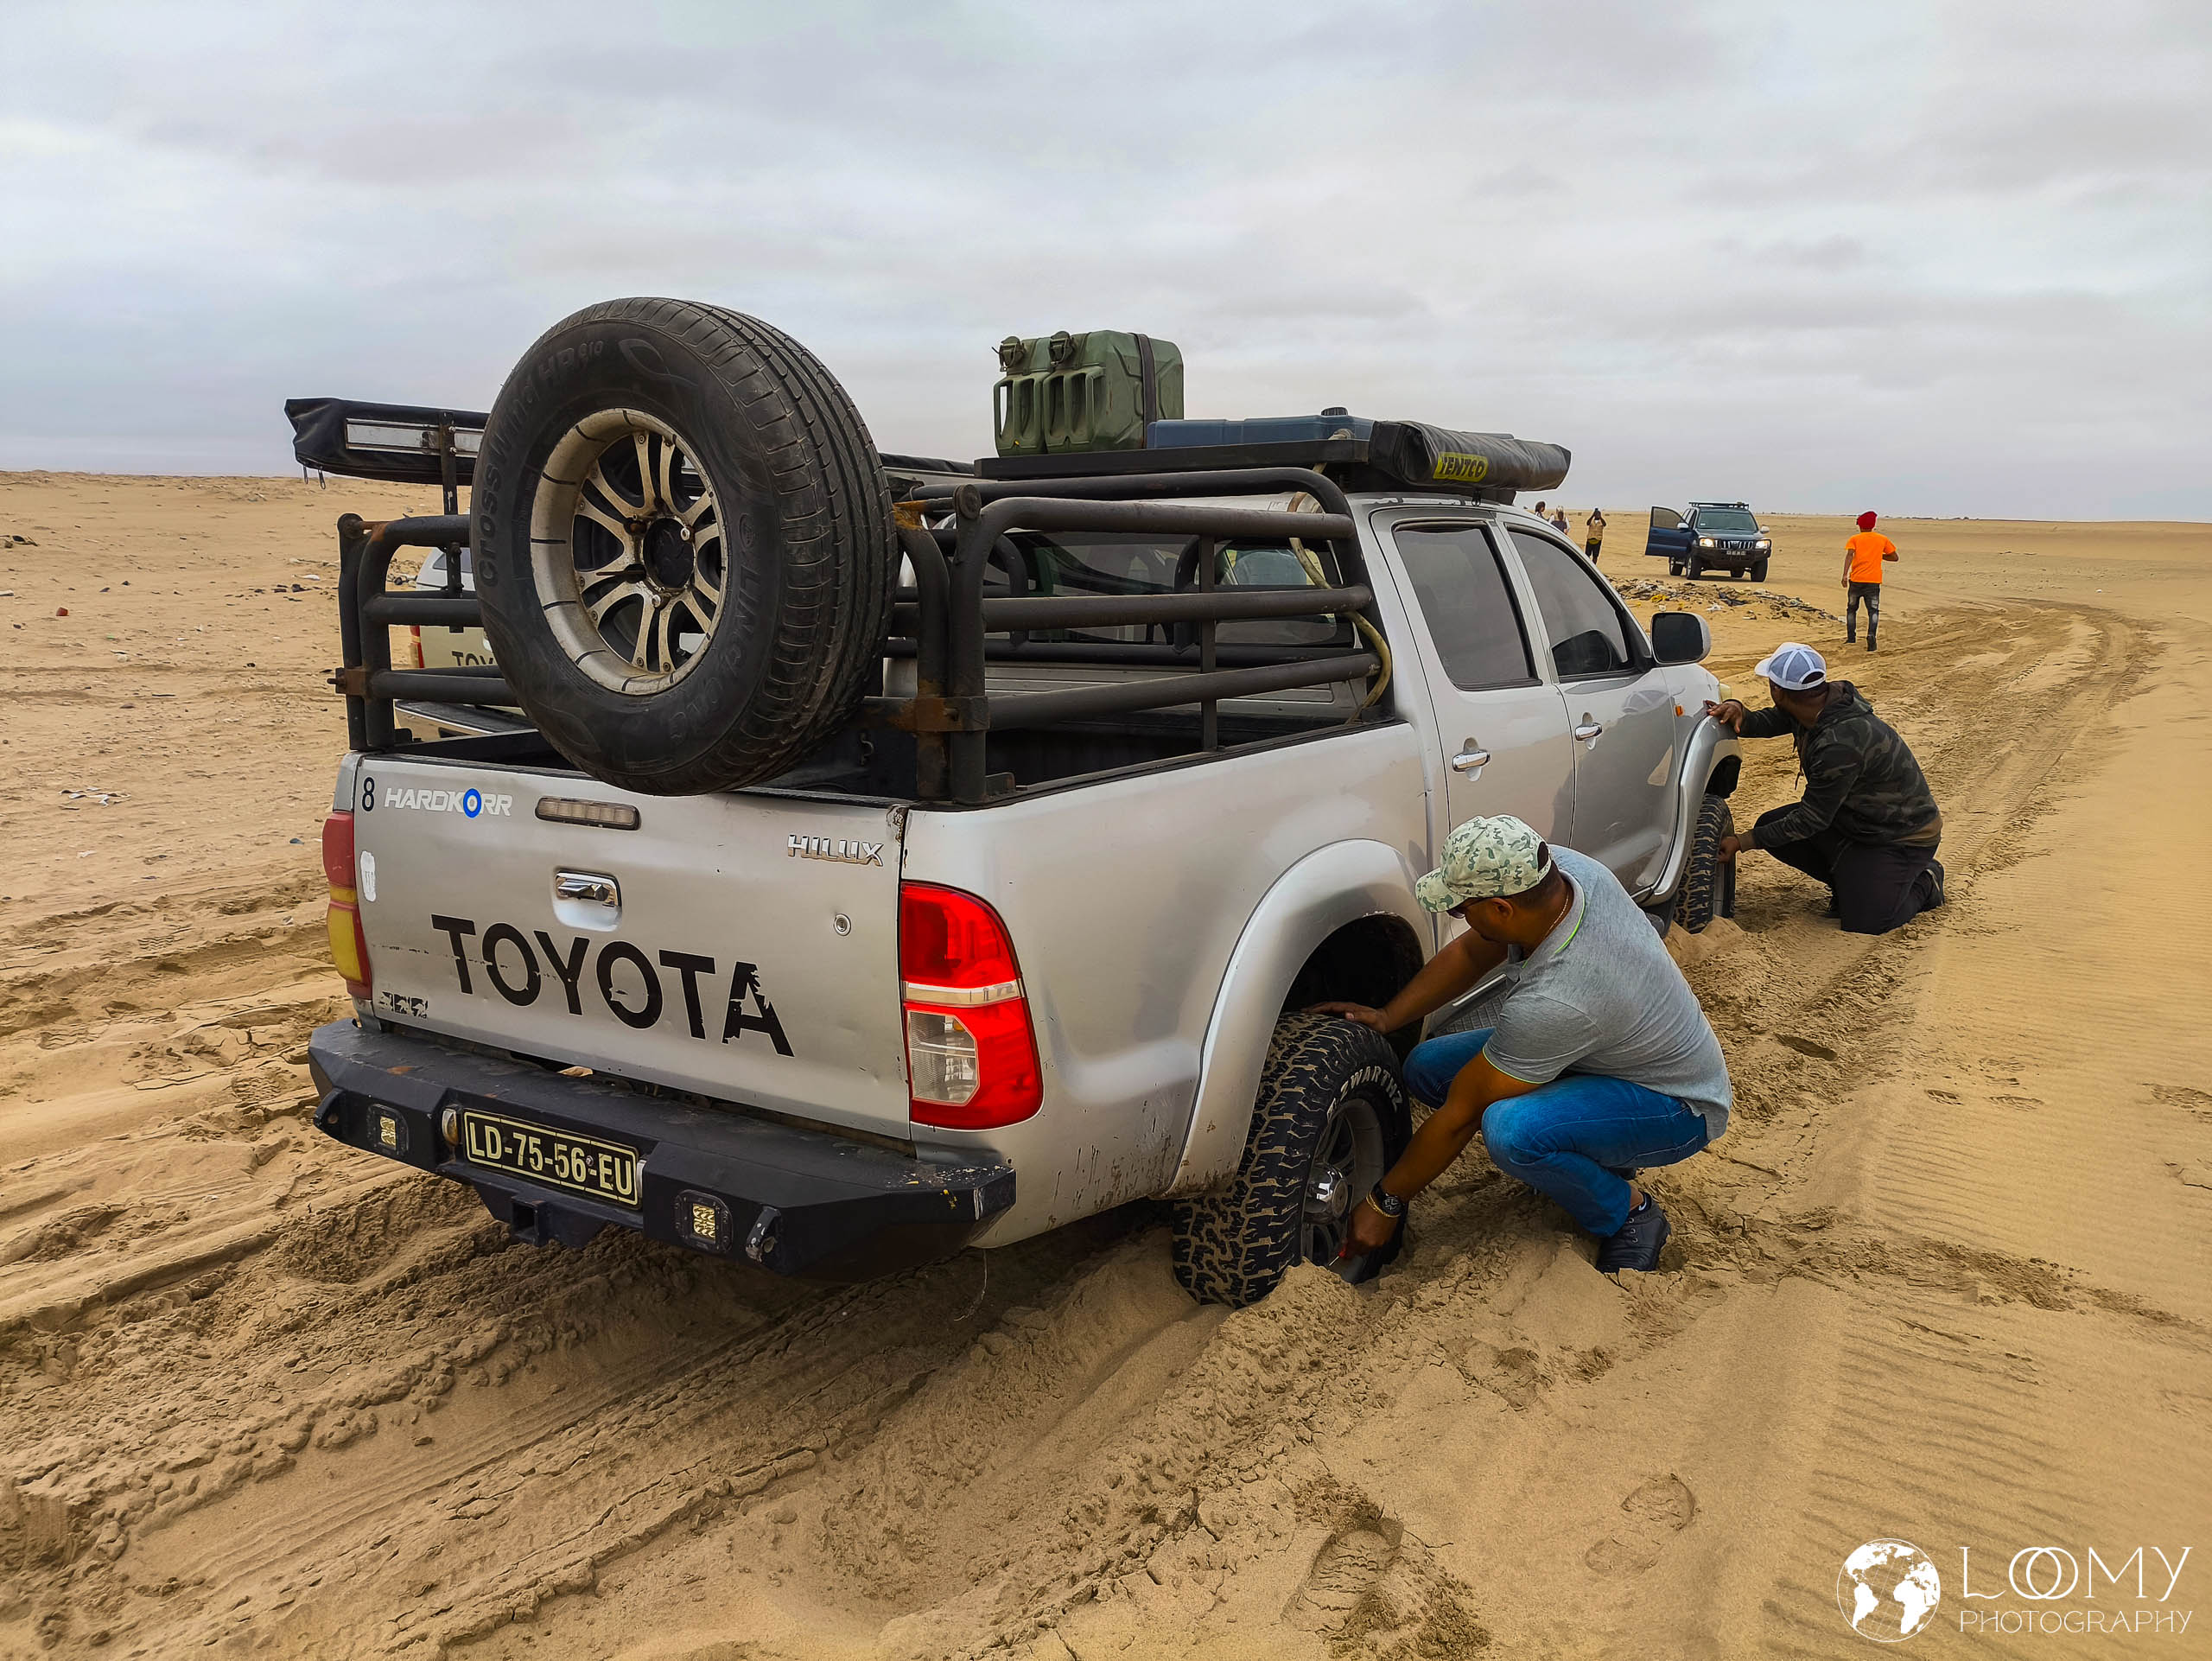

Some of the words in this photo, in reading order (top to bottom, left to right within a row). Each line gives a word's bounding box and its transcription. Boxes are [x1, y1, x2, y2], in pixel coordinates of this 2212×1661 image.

[1439, 456, 1485, 478] TENTCO
[361, 776, 375, 812] 8
[384, 787, 513, 818] HARDKORR
[787, 833, 884, 867] HILUX
[431, 913, 795, 1058] TOYOTA
[469, 1122, 632, 1195] LD-75-56-EU
